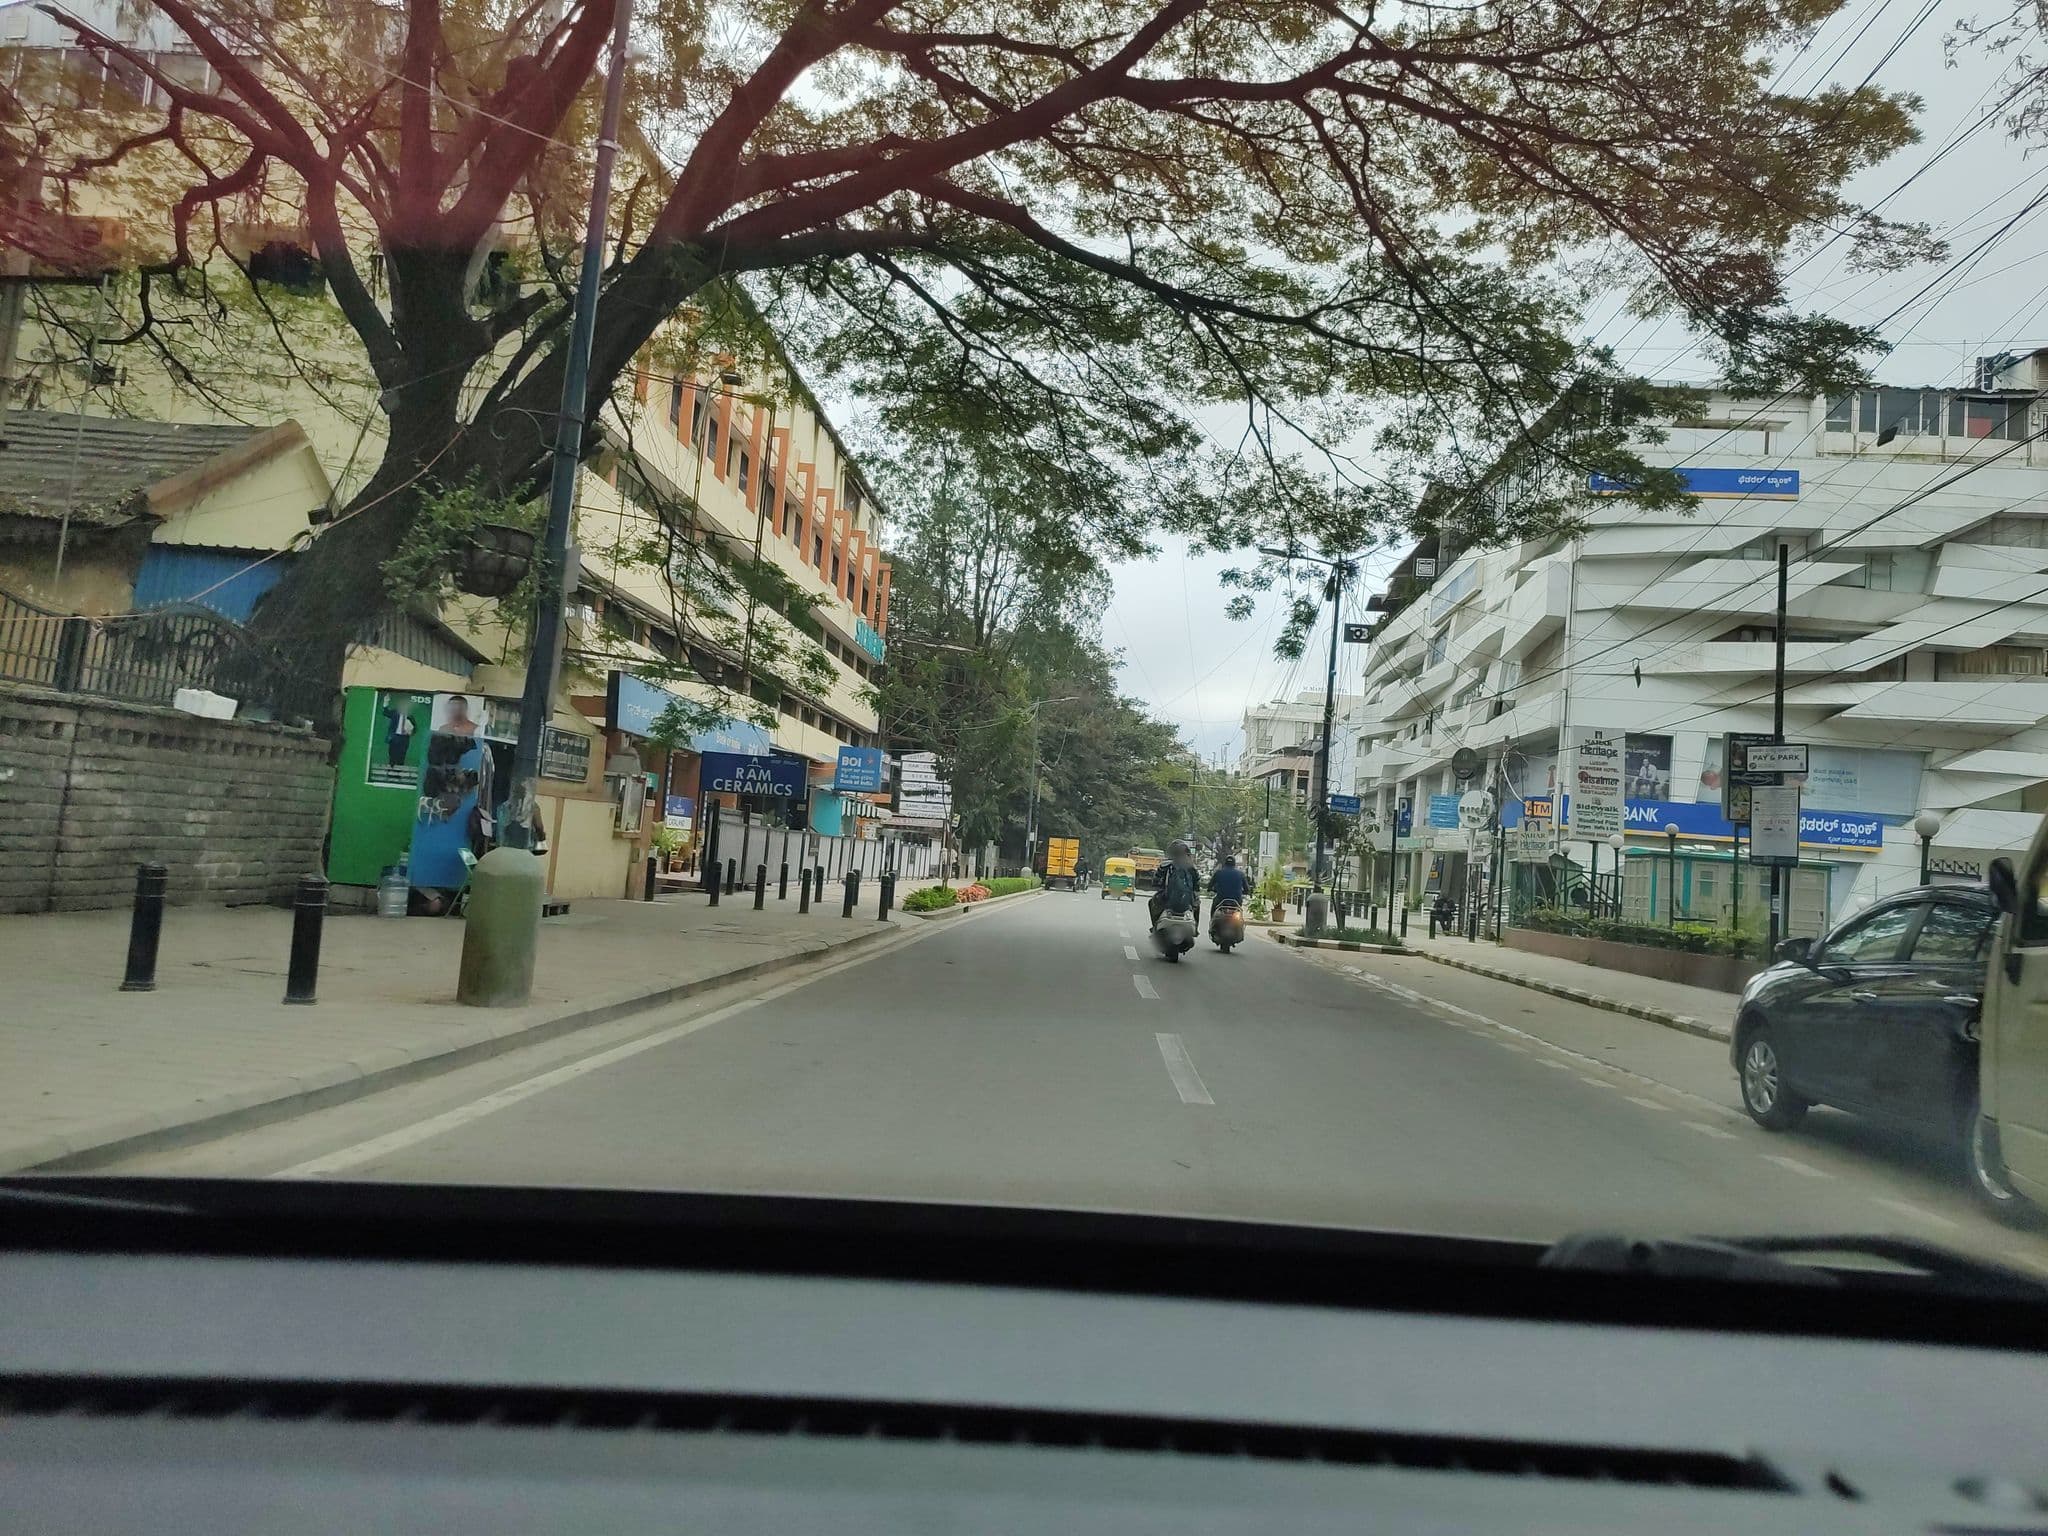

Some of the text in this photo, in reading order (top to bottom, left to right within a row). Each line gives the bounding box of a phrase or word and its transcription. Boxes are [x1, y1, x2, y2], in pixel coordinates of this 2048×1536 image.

[411, 695, 431, 704] SDS
[841, 756, 862, 768] BOI
[735, 767, 772, 782] RAM
[713, 778, 792, 796] CERAMICS
[1526, 803, 1550, 814] ATM
[1576, 804, 1619, 812] Sidewalk
[1624, 806, 1659, 823] BANK
[1841, 822, 1877, 838] ಬ್ಯಾಂಕ್
